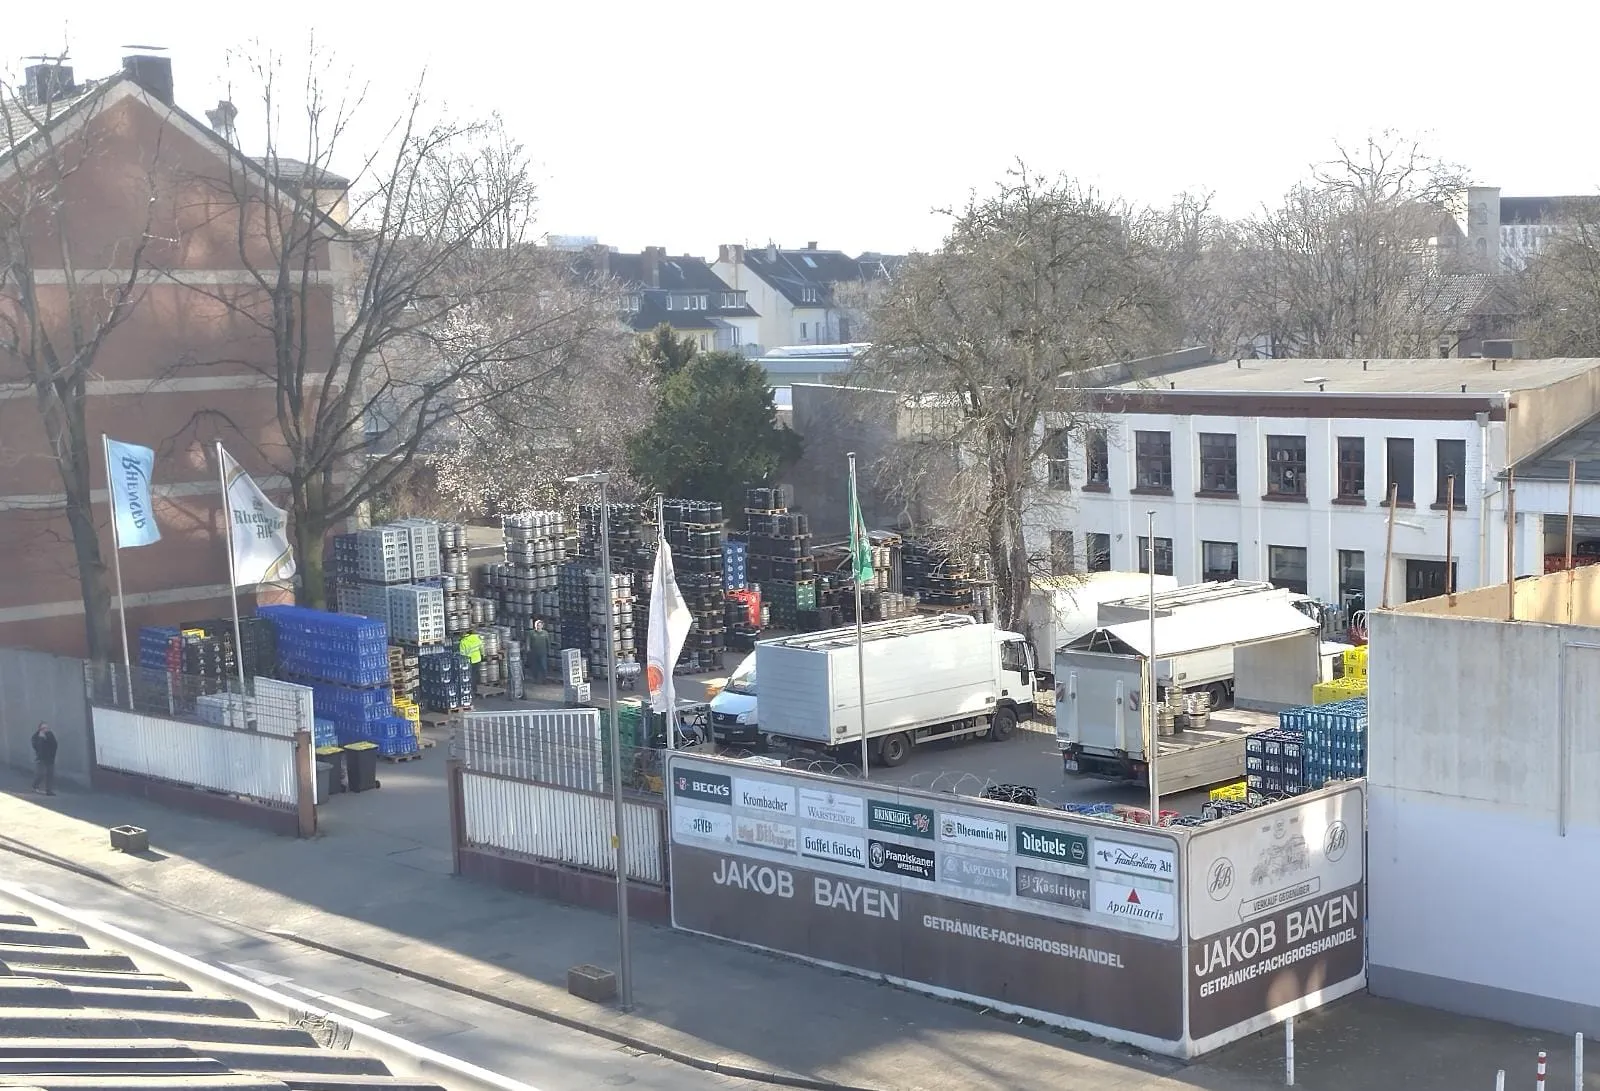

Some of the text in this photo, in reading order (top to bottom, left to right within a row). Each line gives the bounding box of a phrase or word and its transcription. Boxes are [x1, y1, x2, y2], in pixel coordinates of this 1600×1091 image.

[256, 524, 272, 539] Alt
[692, 781, 730, 796] BECK'S
[743, 791, 788, 812] Krombacher
[693, 818, 713, 833] JEVER
[807, 805, 856, 825] WARSTEINER
[756, 823, 796, 849] Bitburger
[956, 822, 1008, 843] Rhenania Alt
[1022, 831, 1066, 857] Diebels
[805, 836, 861, 860] Gaffel Kölsch
[885, 849, 934, 868] Franziskaner
[962, 863, 1009, 881] KAPUZINER
[1114, 848, 1172, 873] Frankenheim Alt
[713, 859, 899, 921] JAKOB BAYEN
[1032, 877, 1087, 900] Köstritzer
[1253, 884, 1310, 912] VERKAUF GEGENÜBER
[1106, 900, 1164, 921] Apollinaris
[923, 913, 1125, 969] GETRÄNKE-FACHGROSSHANDEL
[1195, 891, 1358, 977] JAKOB BAYEN
[1200, 927, 1357, 998] GETRÄNKE-FACHGROSSHANDEL
